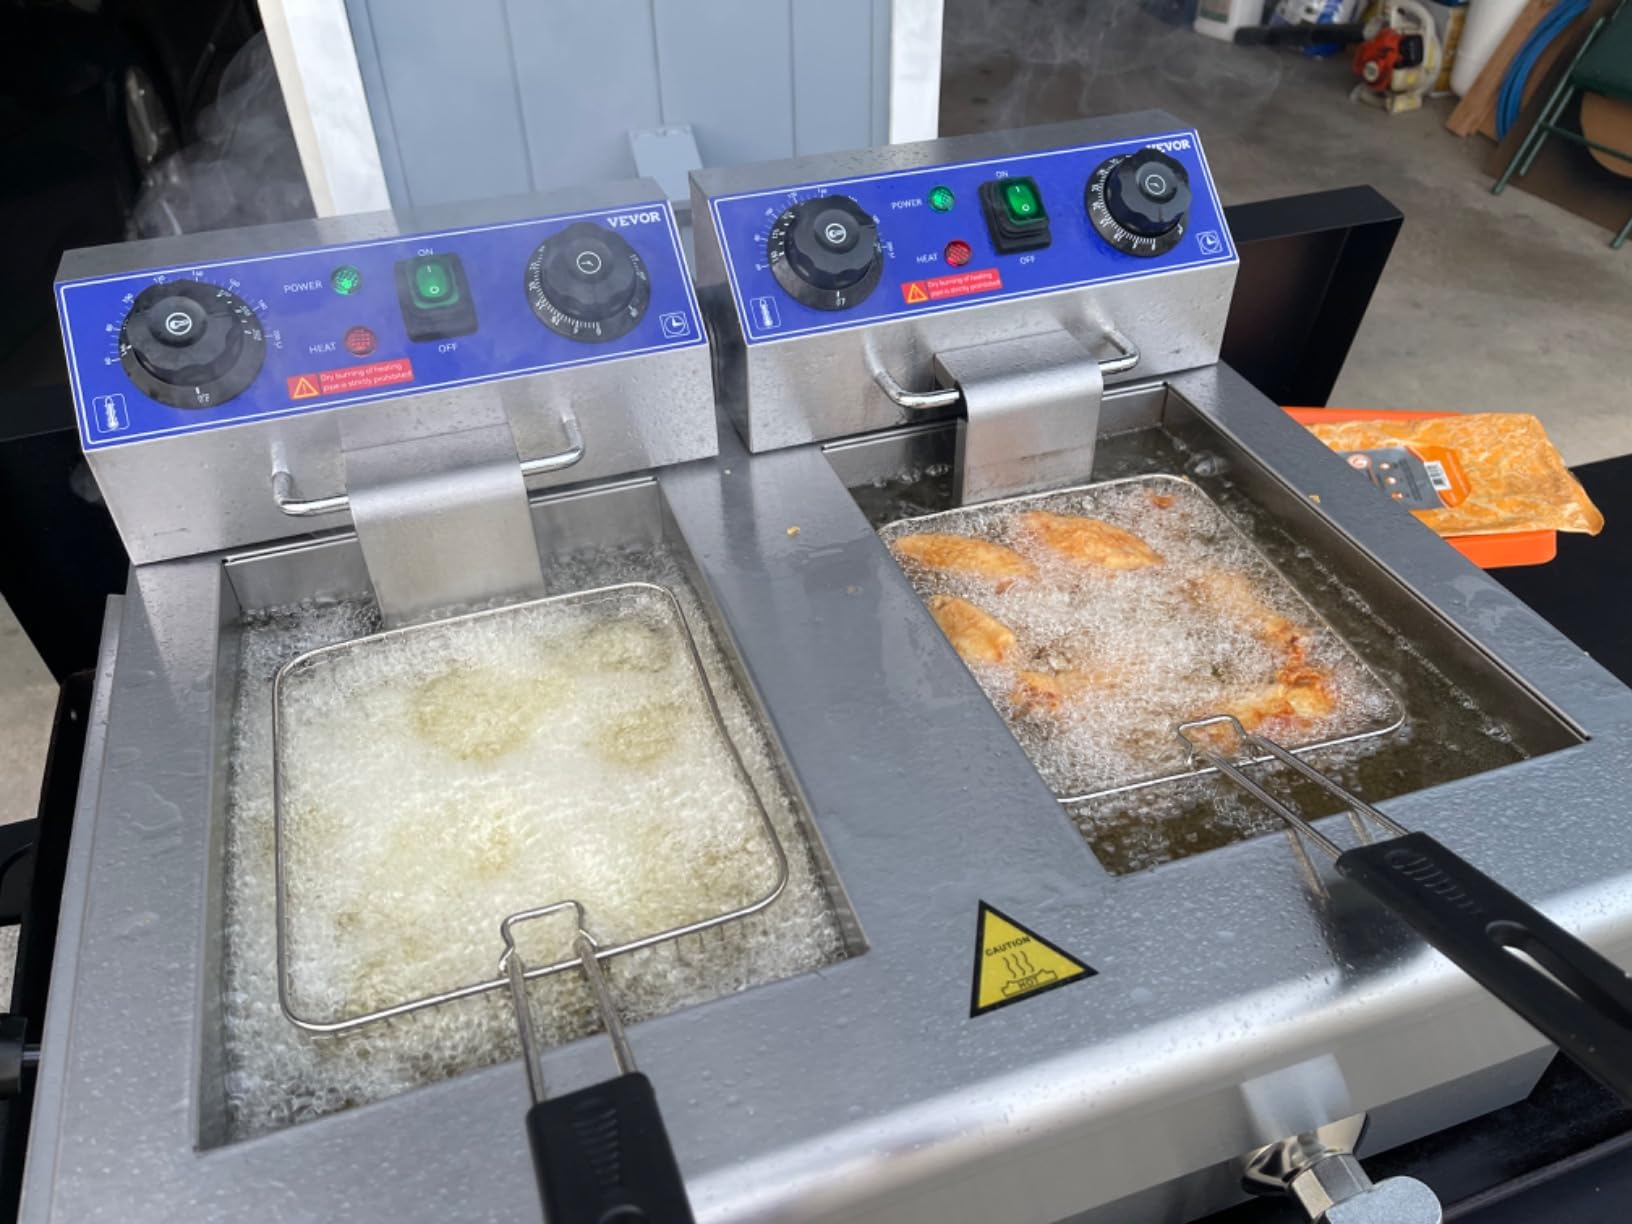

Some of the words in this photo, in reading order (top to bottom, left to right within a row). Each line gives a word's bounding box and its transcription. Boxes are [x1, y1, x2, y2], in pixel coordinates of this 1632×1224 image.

[891, 198, 923, 210] POWER
[607, 212, 661, 228] VEVOR
[417, 248, 433, 257] ON
[916, 253, 938, 264] HEAT
[1019, 255, 1036, 265] OFF
[284, 280, 322, 293] POWER
[309, 342, 336, 354] HEAT
[438, 343, 458, 354] OFF
[985, 936, 1031, 956] CAUTION
